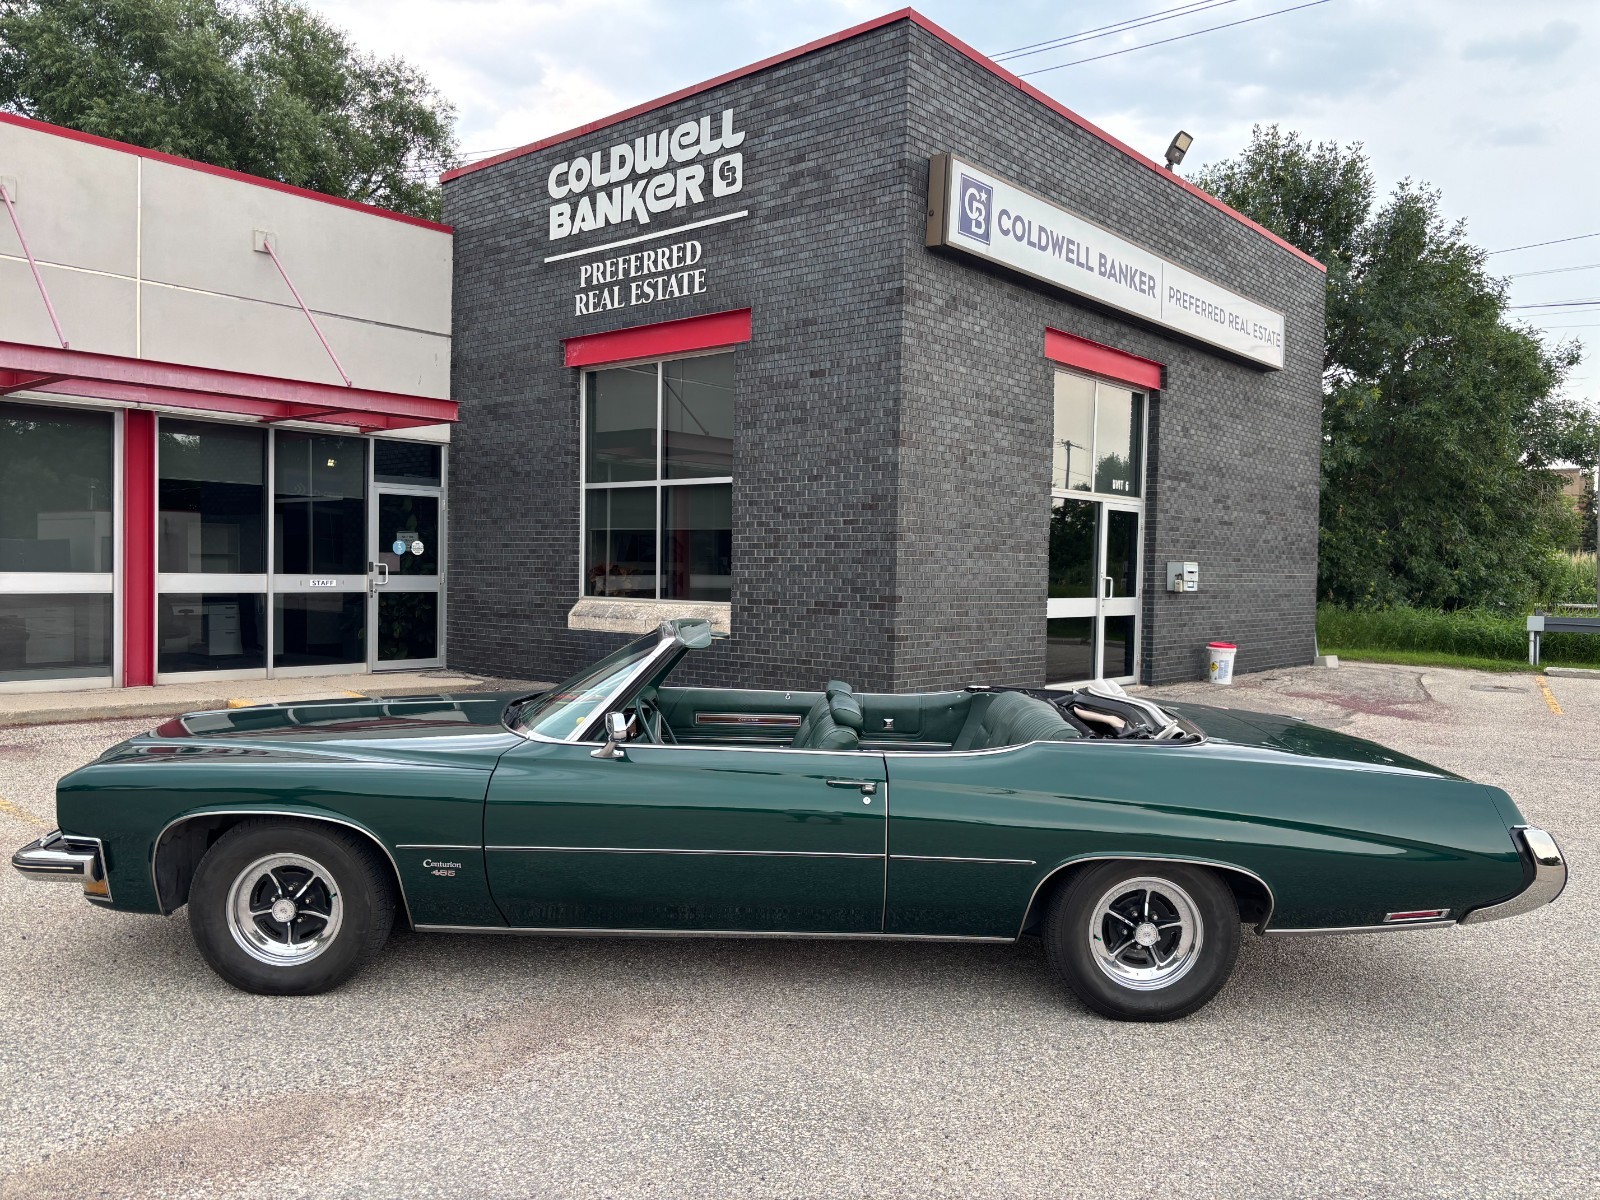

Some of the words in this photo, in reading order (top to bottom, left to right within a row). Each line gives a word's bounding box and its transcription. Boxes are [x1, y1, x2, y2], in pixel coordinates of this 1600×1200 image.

[579, 240, 702, 288] PREFERRED
[997, 208, 1095, 273] COLDWELL
[1098, 252, 1157, 299] BANKER
[575, 285, 625, 317] REAL
[629, 268, 707, 306] ESTATE
[1168, 285, 1226, 325] PREFERRED
[1228, 312, 1251, 336] REAL
[1253, 322, 1281, 348] ESTATE
[422, 858, 462, 869] Centurion
